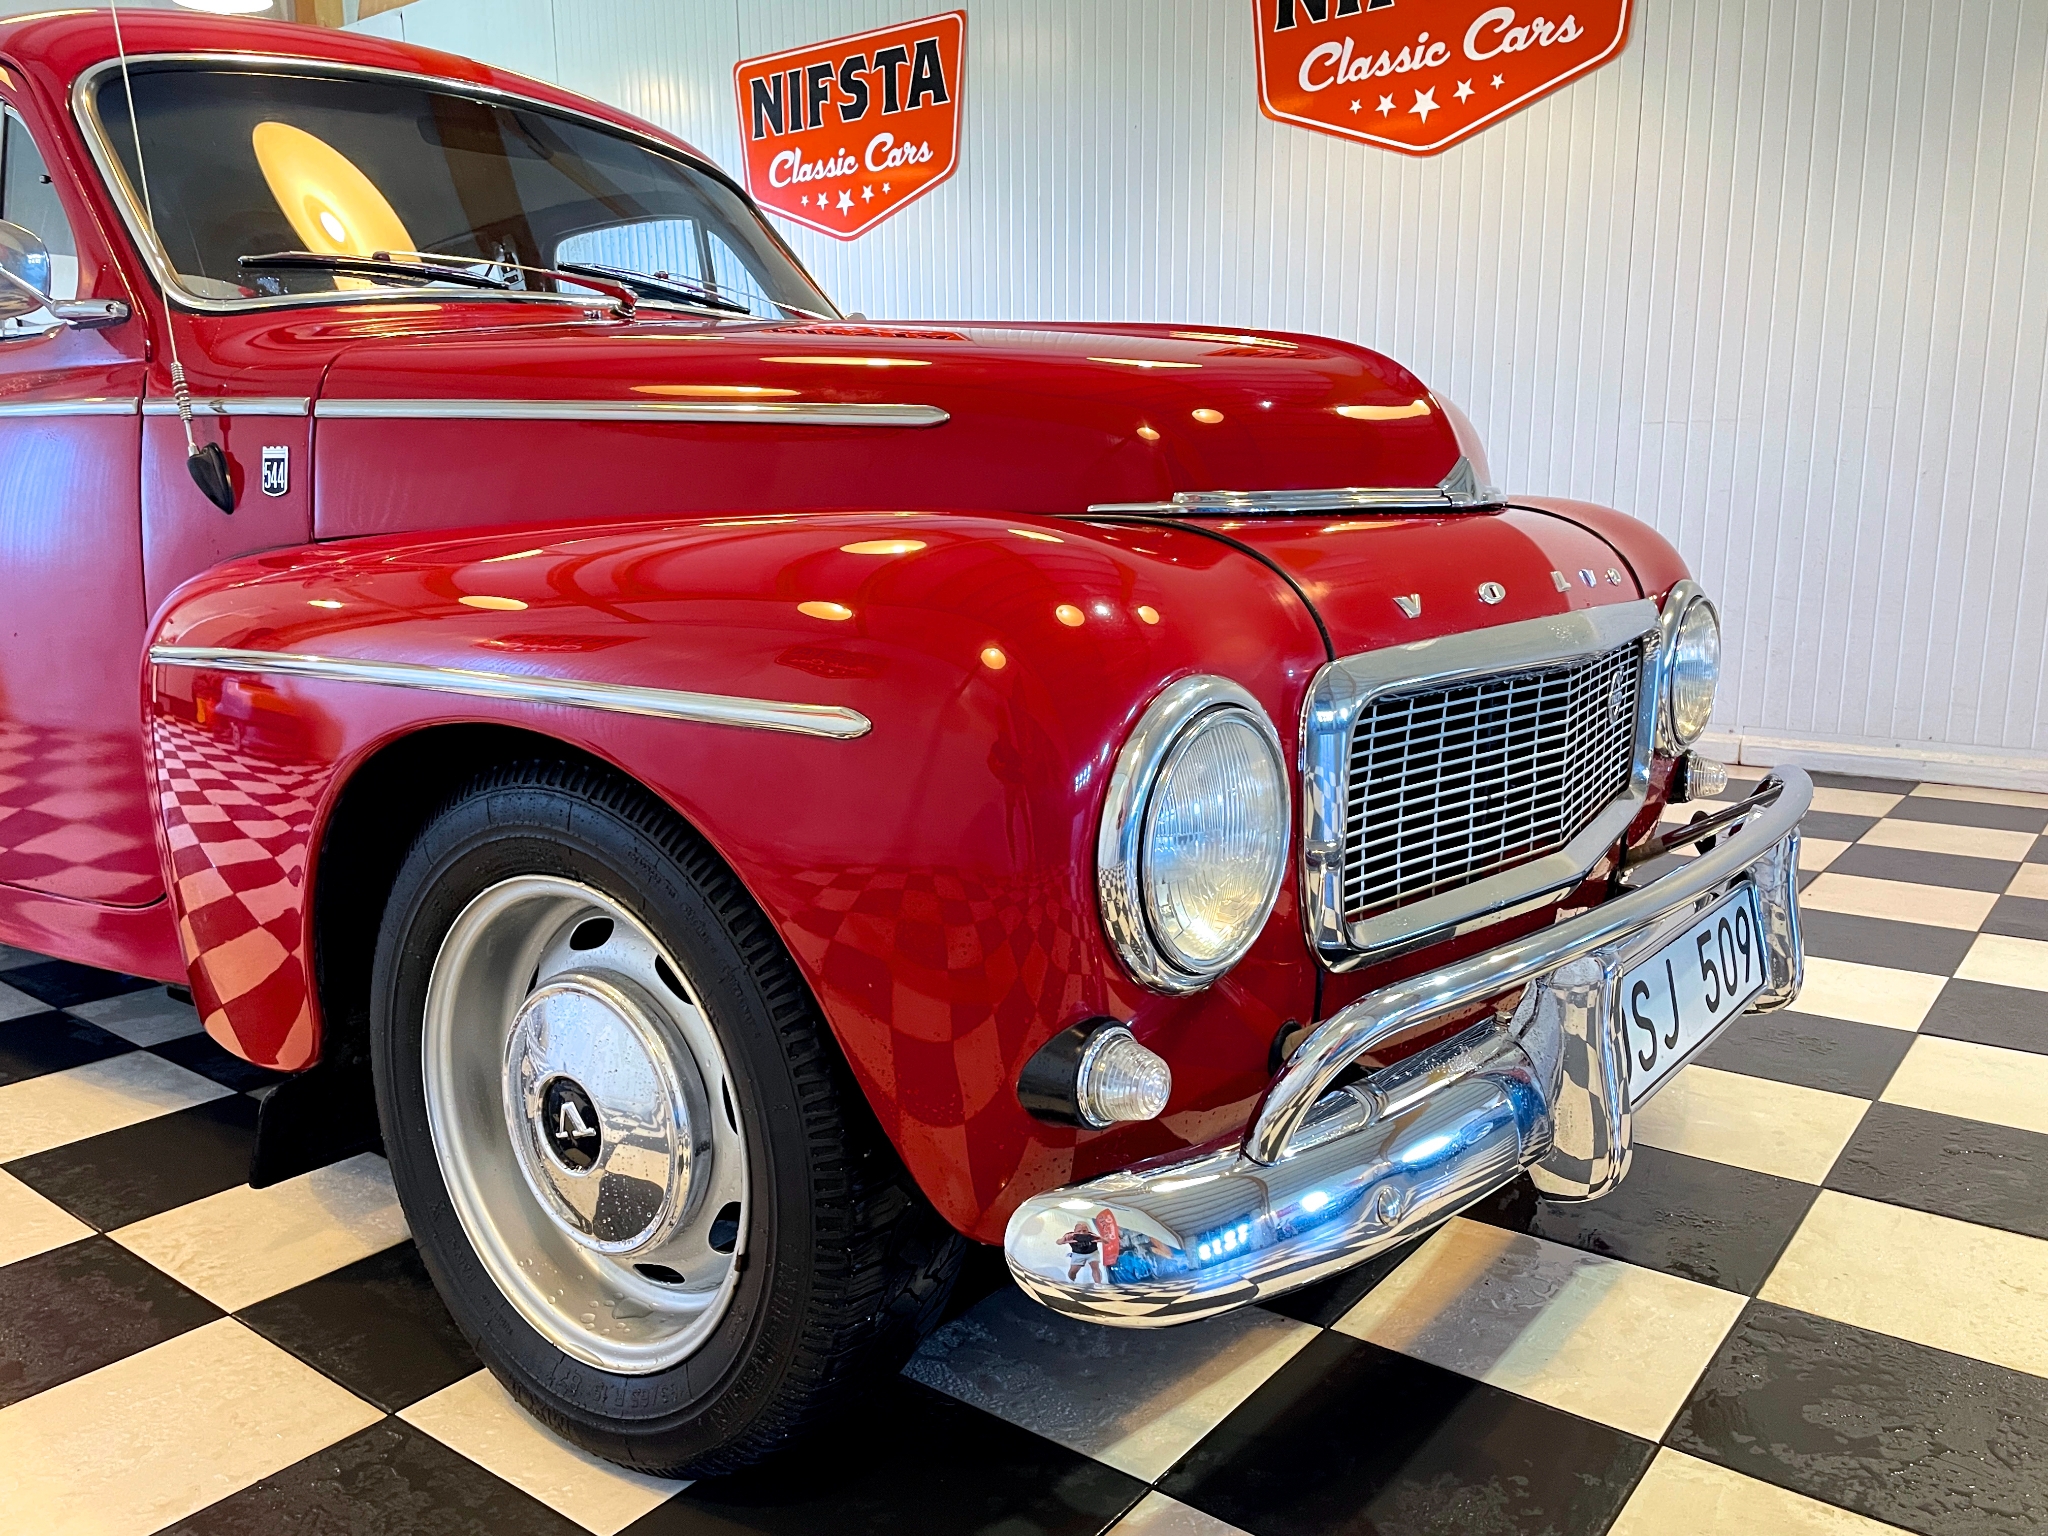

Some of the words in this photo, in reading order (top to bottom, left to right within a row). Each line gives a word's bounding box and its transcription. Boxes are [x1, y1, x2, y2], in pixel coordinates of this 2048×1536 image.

[749, 36, 951, 141] NIFSTA
[1298, 31, 1451, 92] Classic
[1463, 6, 1584, 62] Cars
[768, 147, 859, 188] Classic
[864, 132, 934, 172] Cars
[264, 461, 285, 489] 544
[1631, 958, 1680, 1072] SJ
[1696, 905, 1751, 1014] 509
